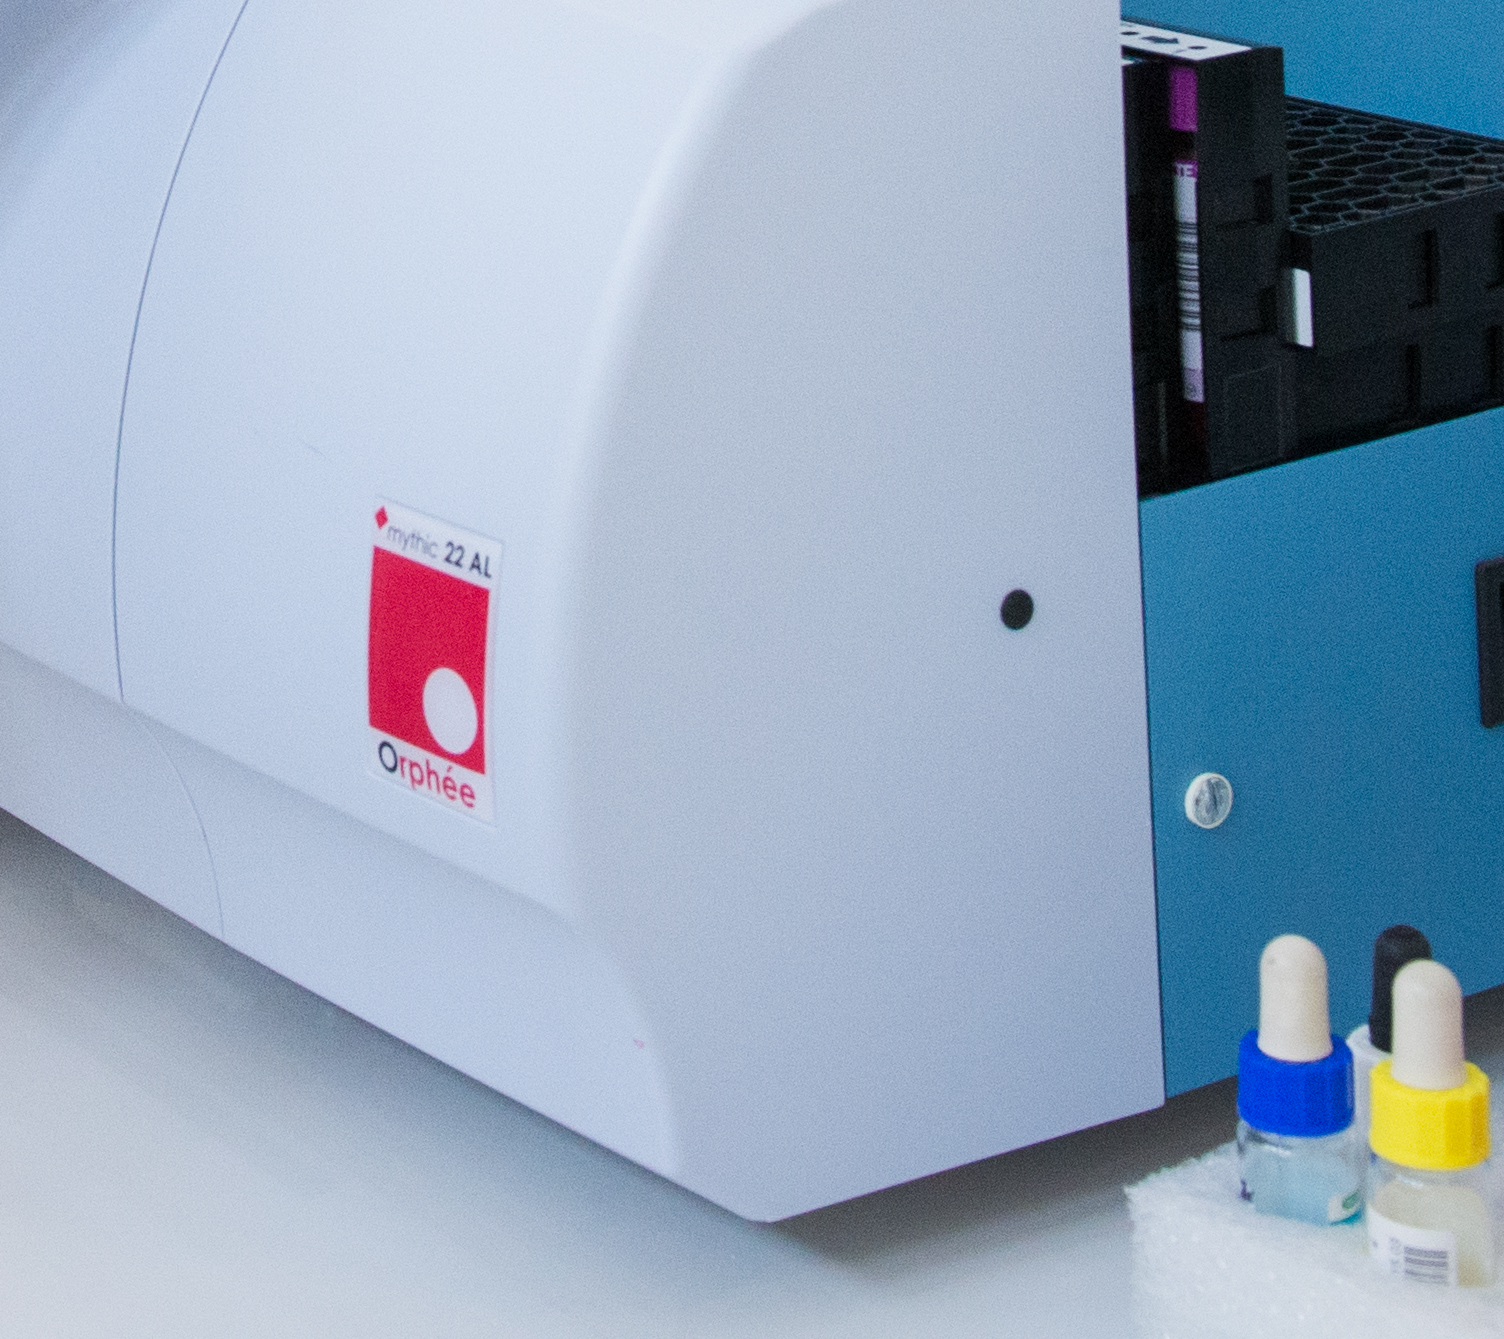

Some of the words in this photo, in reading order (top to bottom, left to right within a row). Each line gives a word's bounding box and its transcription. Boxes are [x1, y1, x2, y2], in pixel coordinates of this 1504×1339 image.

[387, 526, 438, 559] mythic
[444, 540, 465, 569] 22
[469, 551, 492, 579] AL
[377, 739, 476, 809] Orphée
